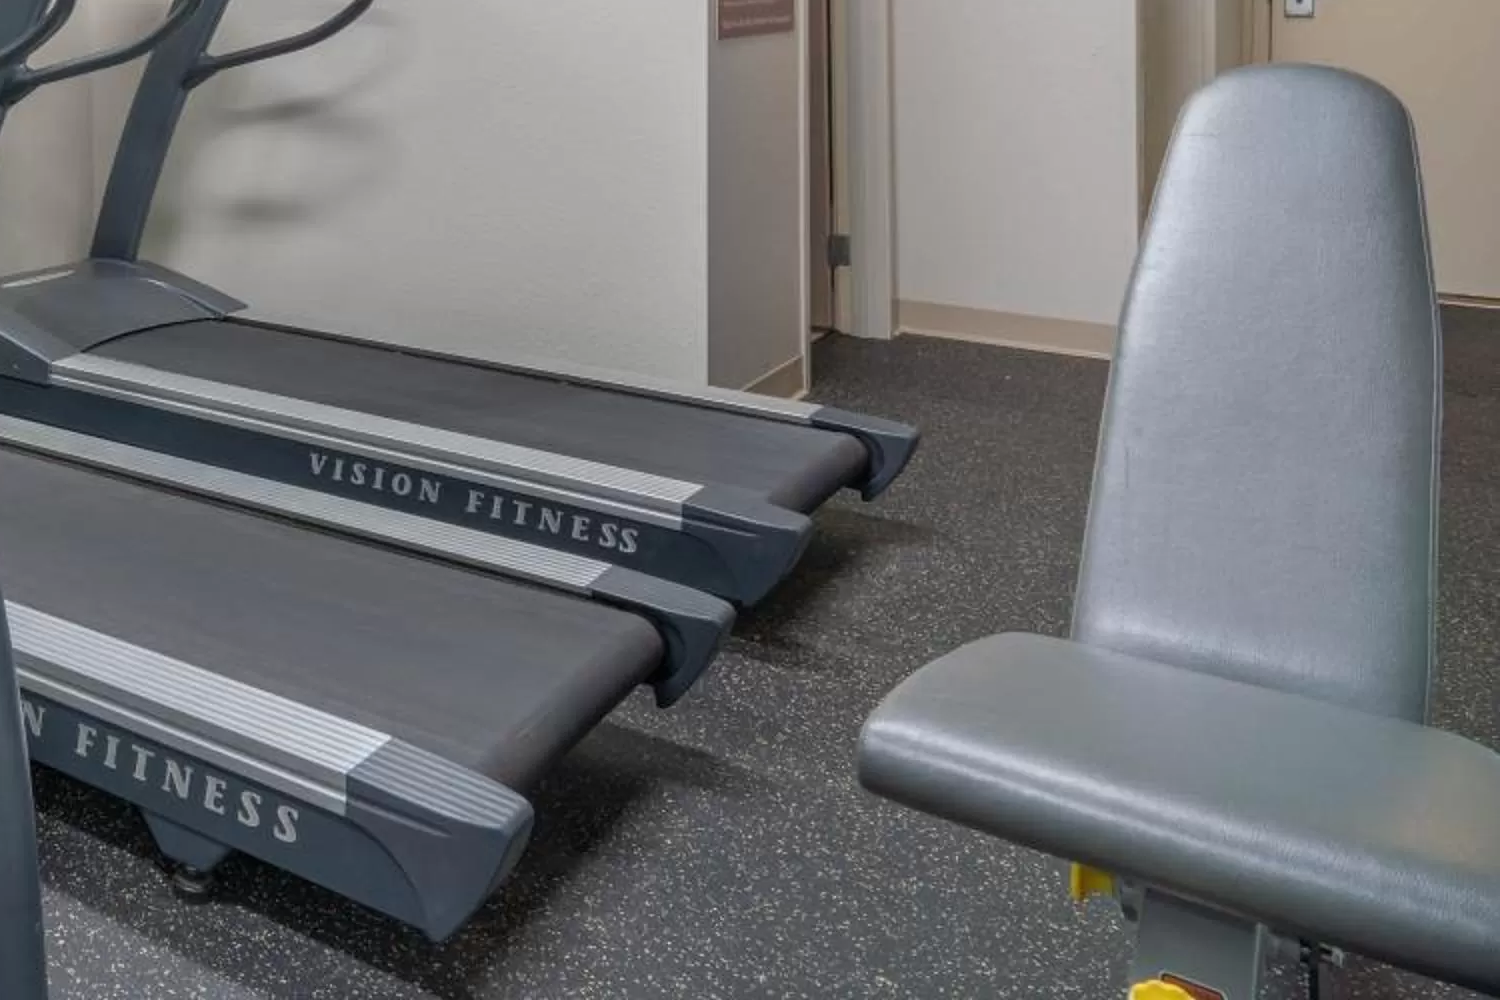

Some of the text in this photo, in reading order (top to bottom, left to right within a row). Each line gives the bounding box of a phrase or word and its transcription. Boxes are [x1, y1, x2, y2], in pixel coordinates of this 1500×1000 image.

[309, 453, 638, 553] VISION FITNESS
[75, 723, 299, 843] FITNESS
